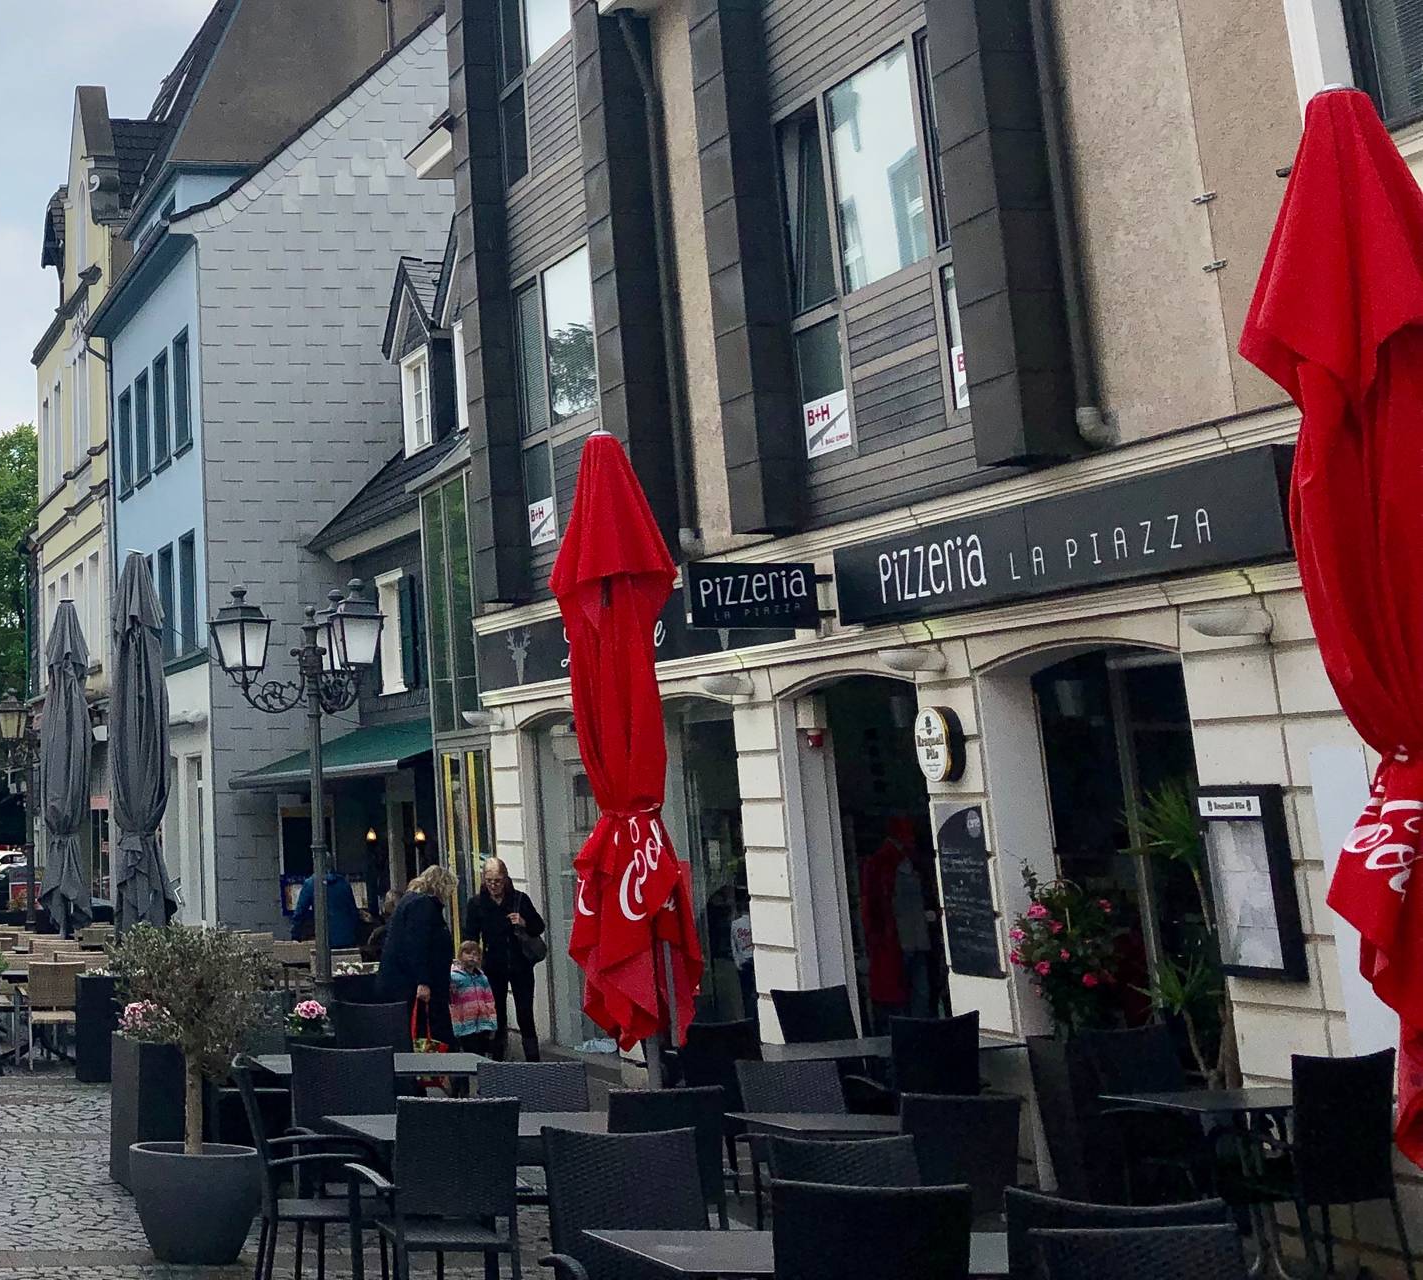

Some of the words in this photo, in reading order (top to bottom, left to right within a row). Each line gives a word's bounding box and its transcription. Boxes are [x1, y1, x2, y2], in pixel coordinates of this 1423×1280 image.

[807, 403, 830, 427] B+H
[530, 506, 545, 522] B+H
[879, 534, 987, 604] Pizzeria
[1009, 546, 1046, 581] LA
[1065, 508, 1212, 570] PIAZZA
[699, 569, 808, 608] Pizzeria
[713, 610, 731, 622] LA
[744, 602, 801, 617] PIAZZA
